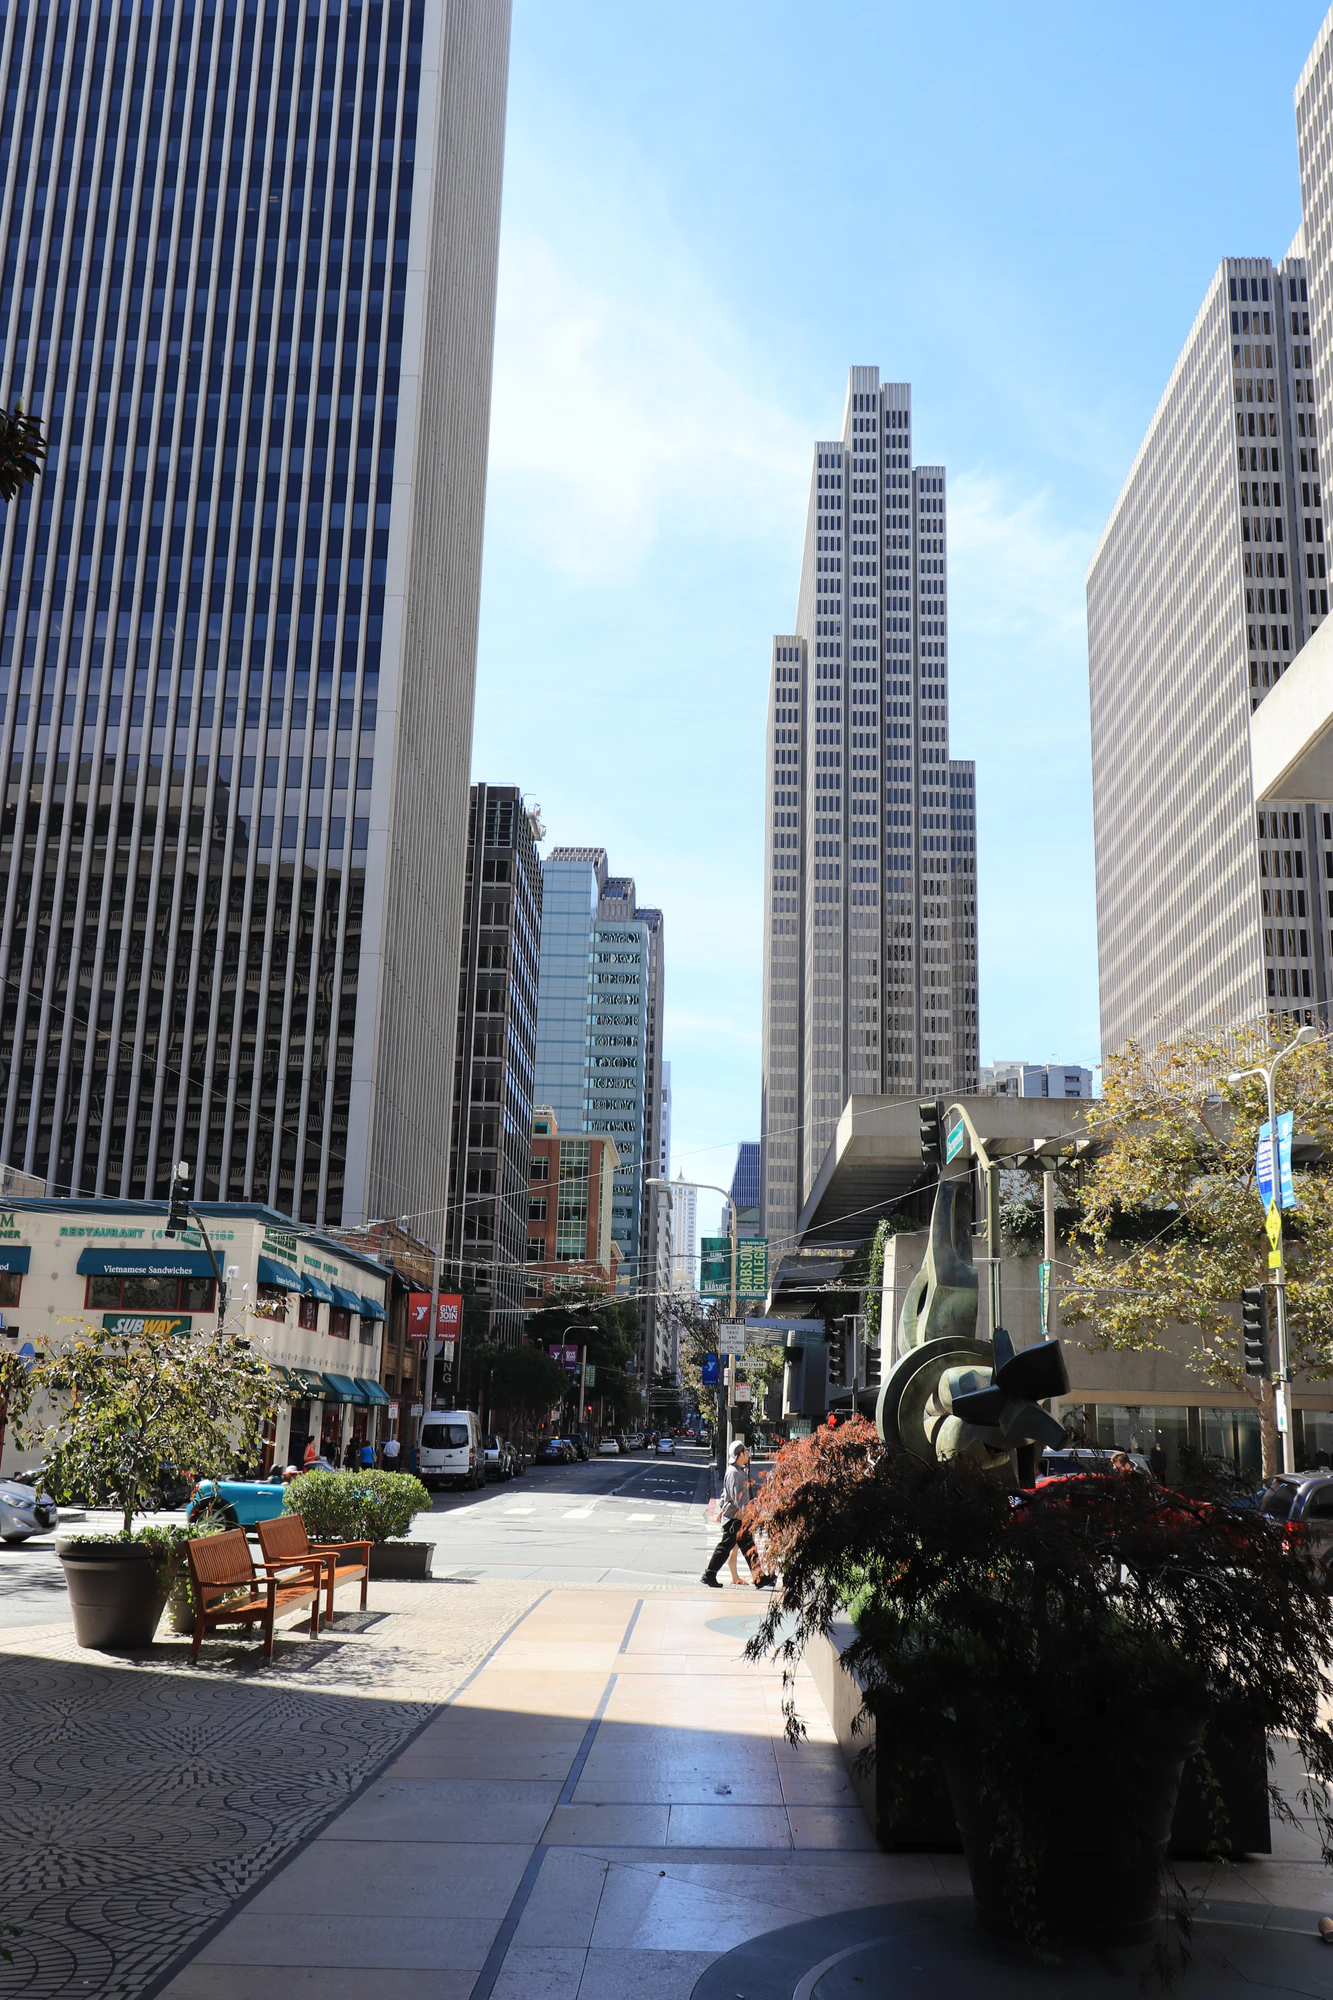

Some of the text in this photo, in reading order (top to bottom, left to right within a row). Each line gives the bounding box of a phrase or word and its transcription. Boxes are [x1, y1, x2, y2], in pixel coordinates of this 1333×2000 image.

[60, 1226, 145, 1238] RESTAURANT
[103, 1265, 193, 1275] Vietnamese Sandwiches
[740, 1245, 753, 1292] BABSON
[440, 1312, 458, 1320] JOIN
[111, 1318, 182, 1334] SUBWAY
